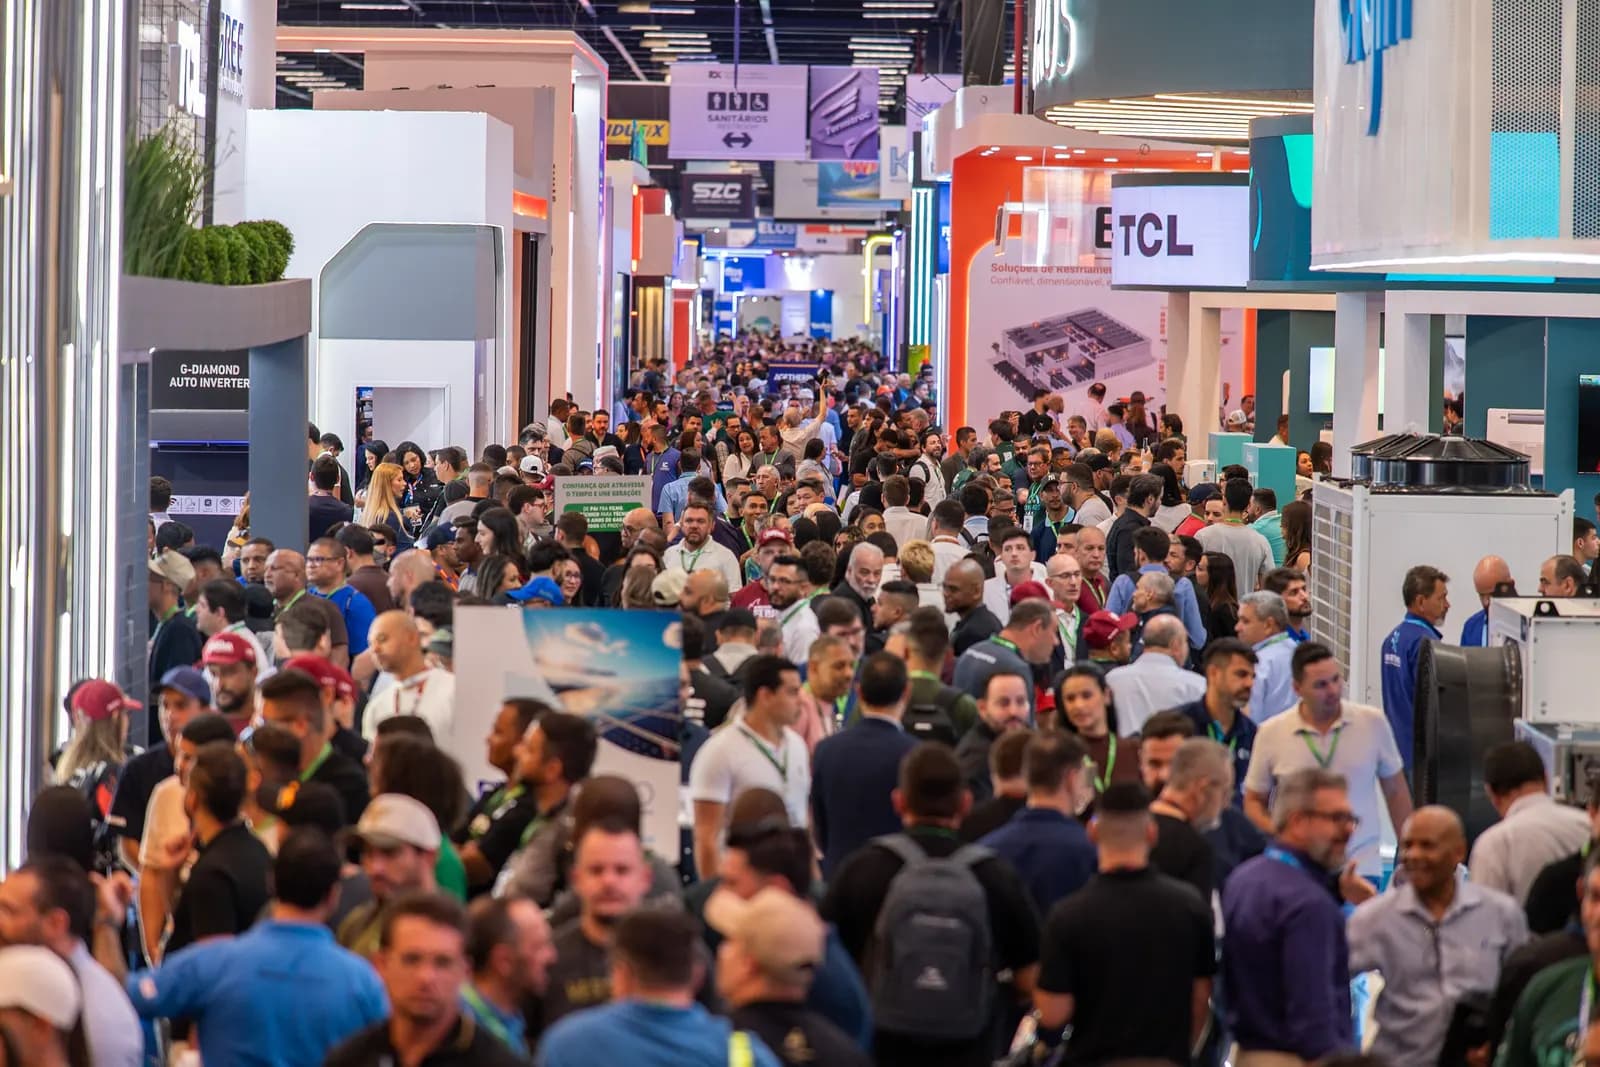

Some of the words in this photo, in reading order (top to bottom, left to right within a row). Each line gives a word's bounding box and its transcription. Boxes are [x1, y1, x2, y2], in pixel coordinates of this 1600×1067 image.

[707, 113, 769, 123] SANITÁRIOS
[692, 182, 742, 199] SZC
[1119, 212, 1194, 258] TCL
[180, 363, 240, 376] G-DIAMOND
[169, 377, 197, 388] AUTO
[200, 377, 250, 389] INVERTER
[612, 489, 641, 497] GERAÇÕES
